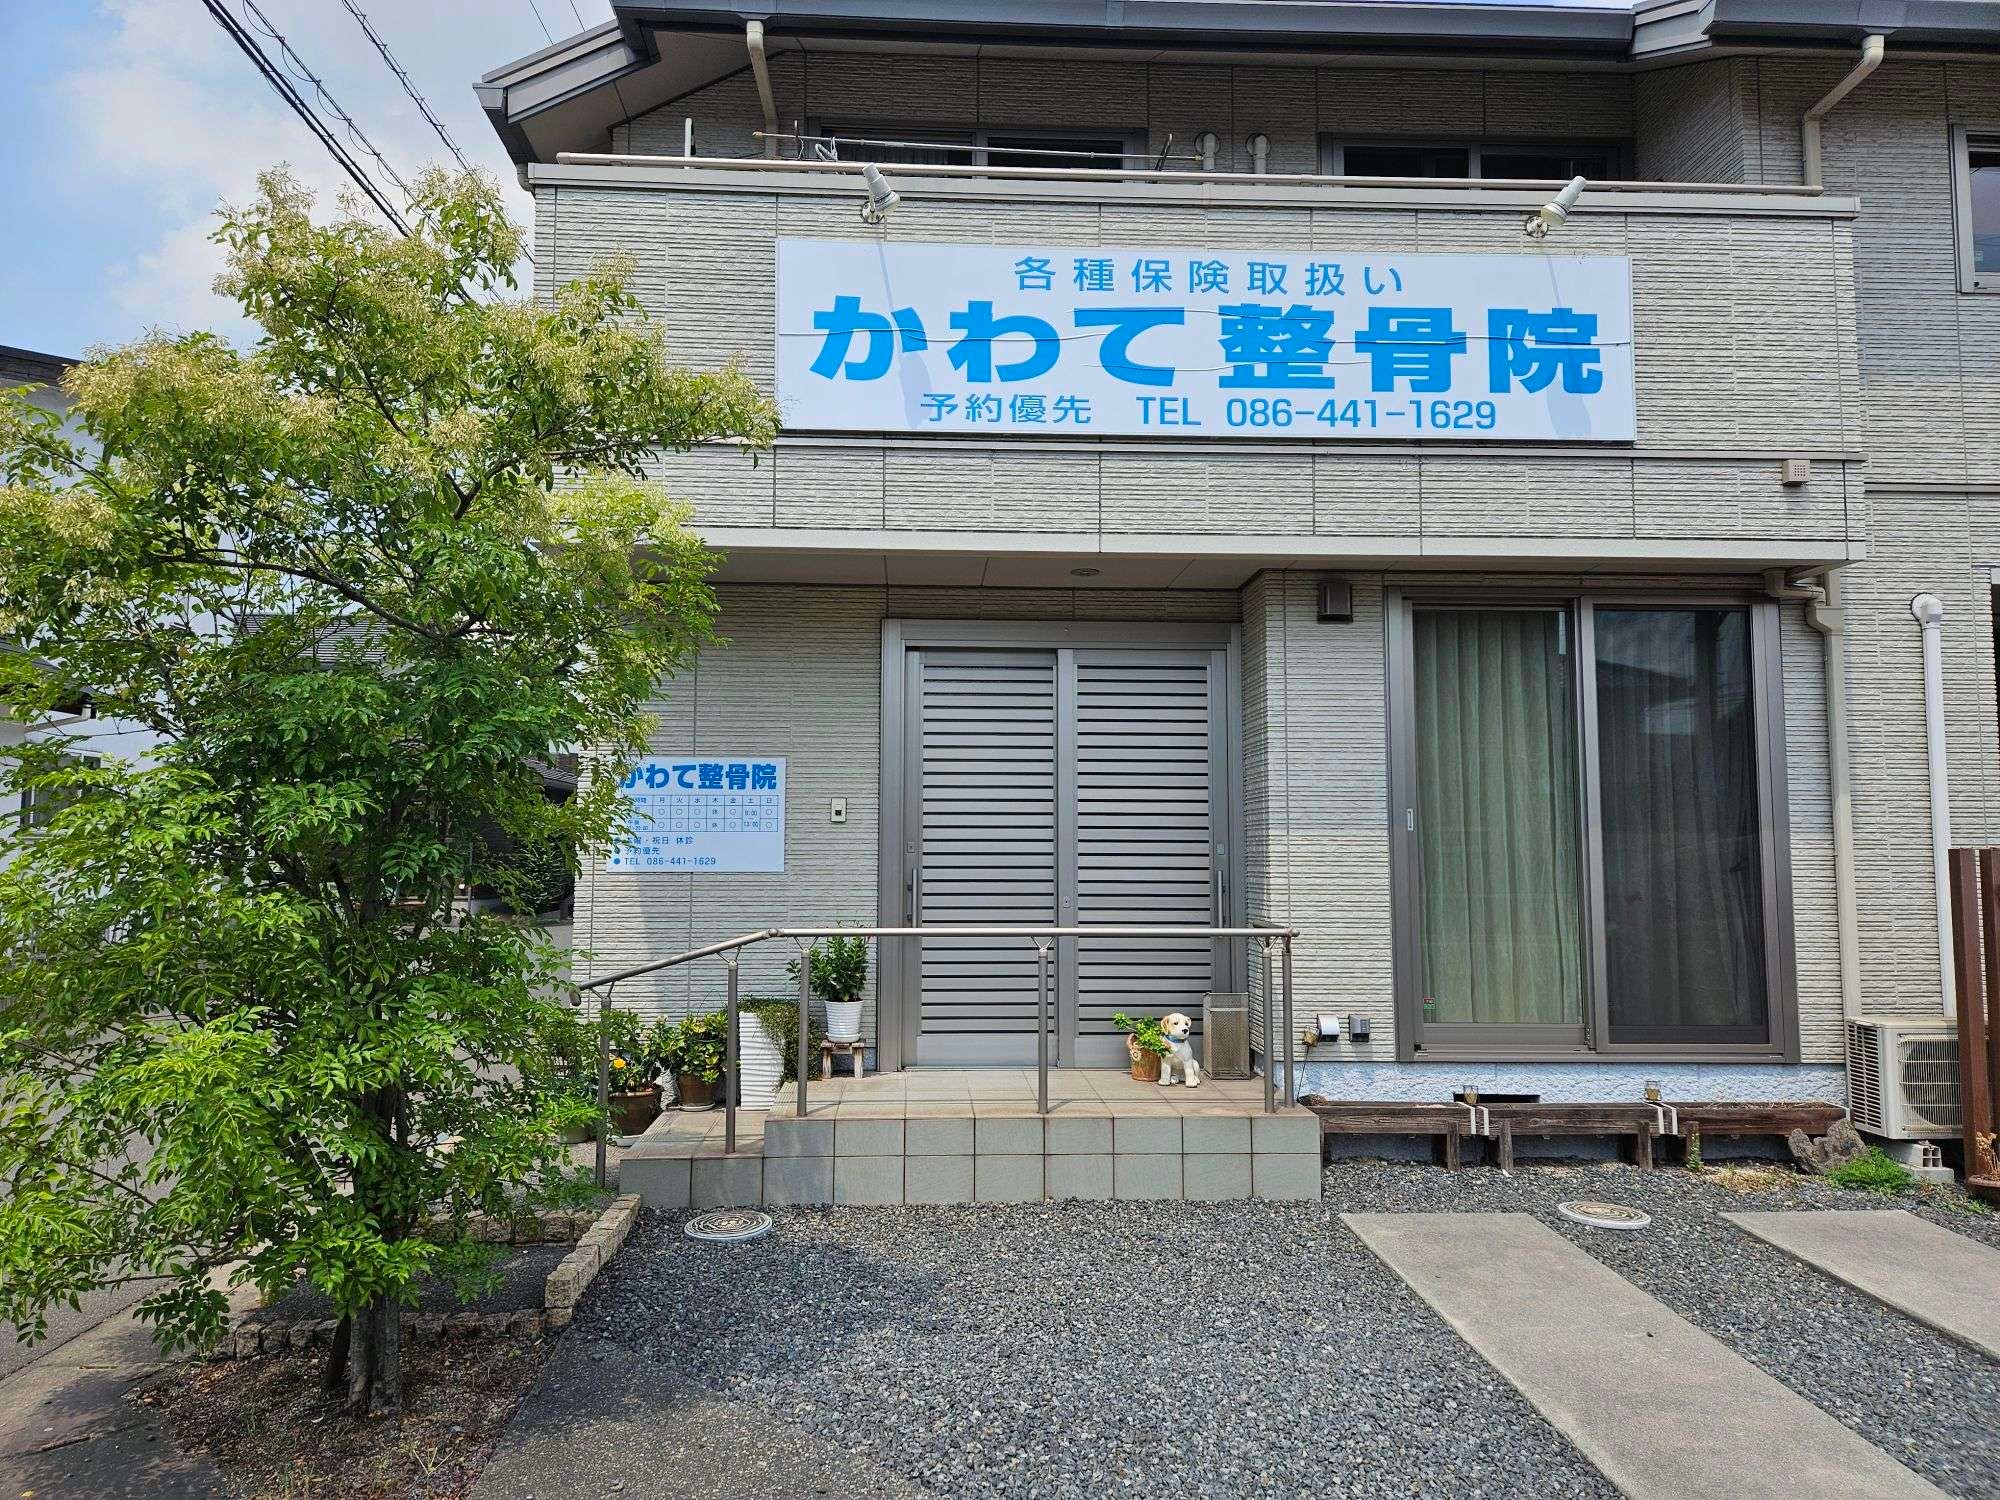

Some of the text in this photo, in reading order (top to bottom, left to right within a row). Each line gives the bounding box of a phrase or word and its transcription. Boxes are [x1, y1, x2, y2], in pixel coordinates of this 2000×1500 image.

[1014, 256, 1403, 296] 各種保険取扱い
[809, 294, 1603, 394] かわて整骨院
[920, 393, 1497, 430] 予約優先 TEL 086-441-1629
[624, 857, 716, 866] TEL 086-441-1629
